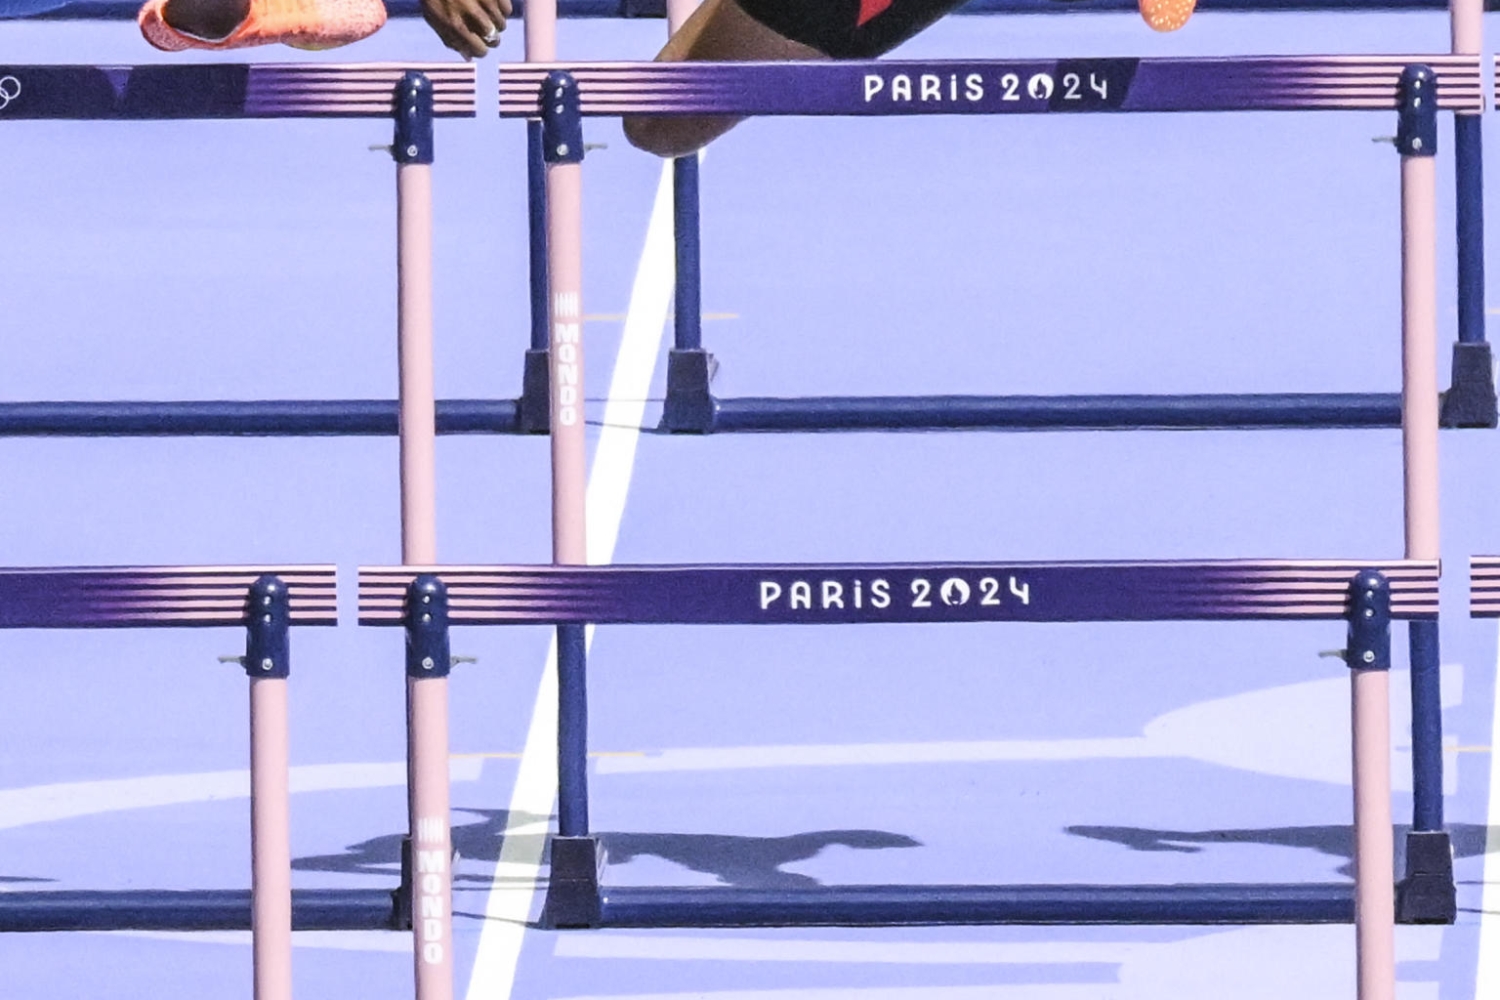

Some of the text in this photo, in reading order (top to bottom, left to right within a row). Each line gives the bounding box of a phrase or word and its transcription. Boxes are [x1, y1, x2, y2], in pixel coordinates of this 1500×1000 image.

[1001, 73, 1108, 100] 2024
[554, 322, 579, 426] MONDO
[910, 576, 1029, 607] 2024
[418, 850, 445, 964] MONDO
